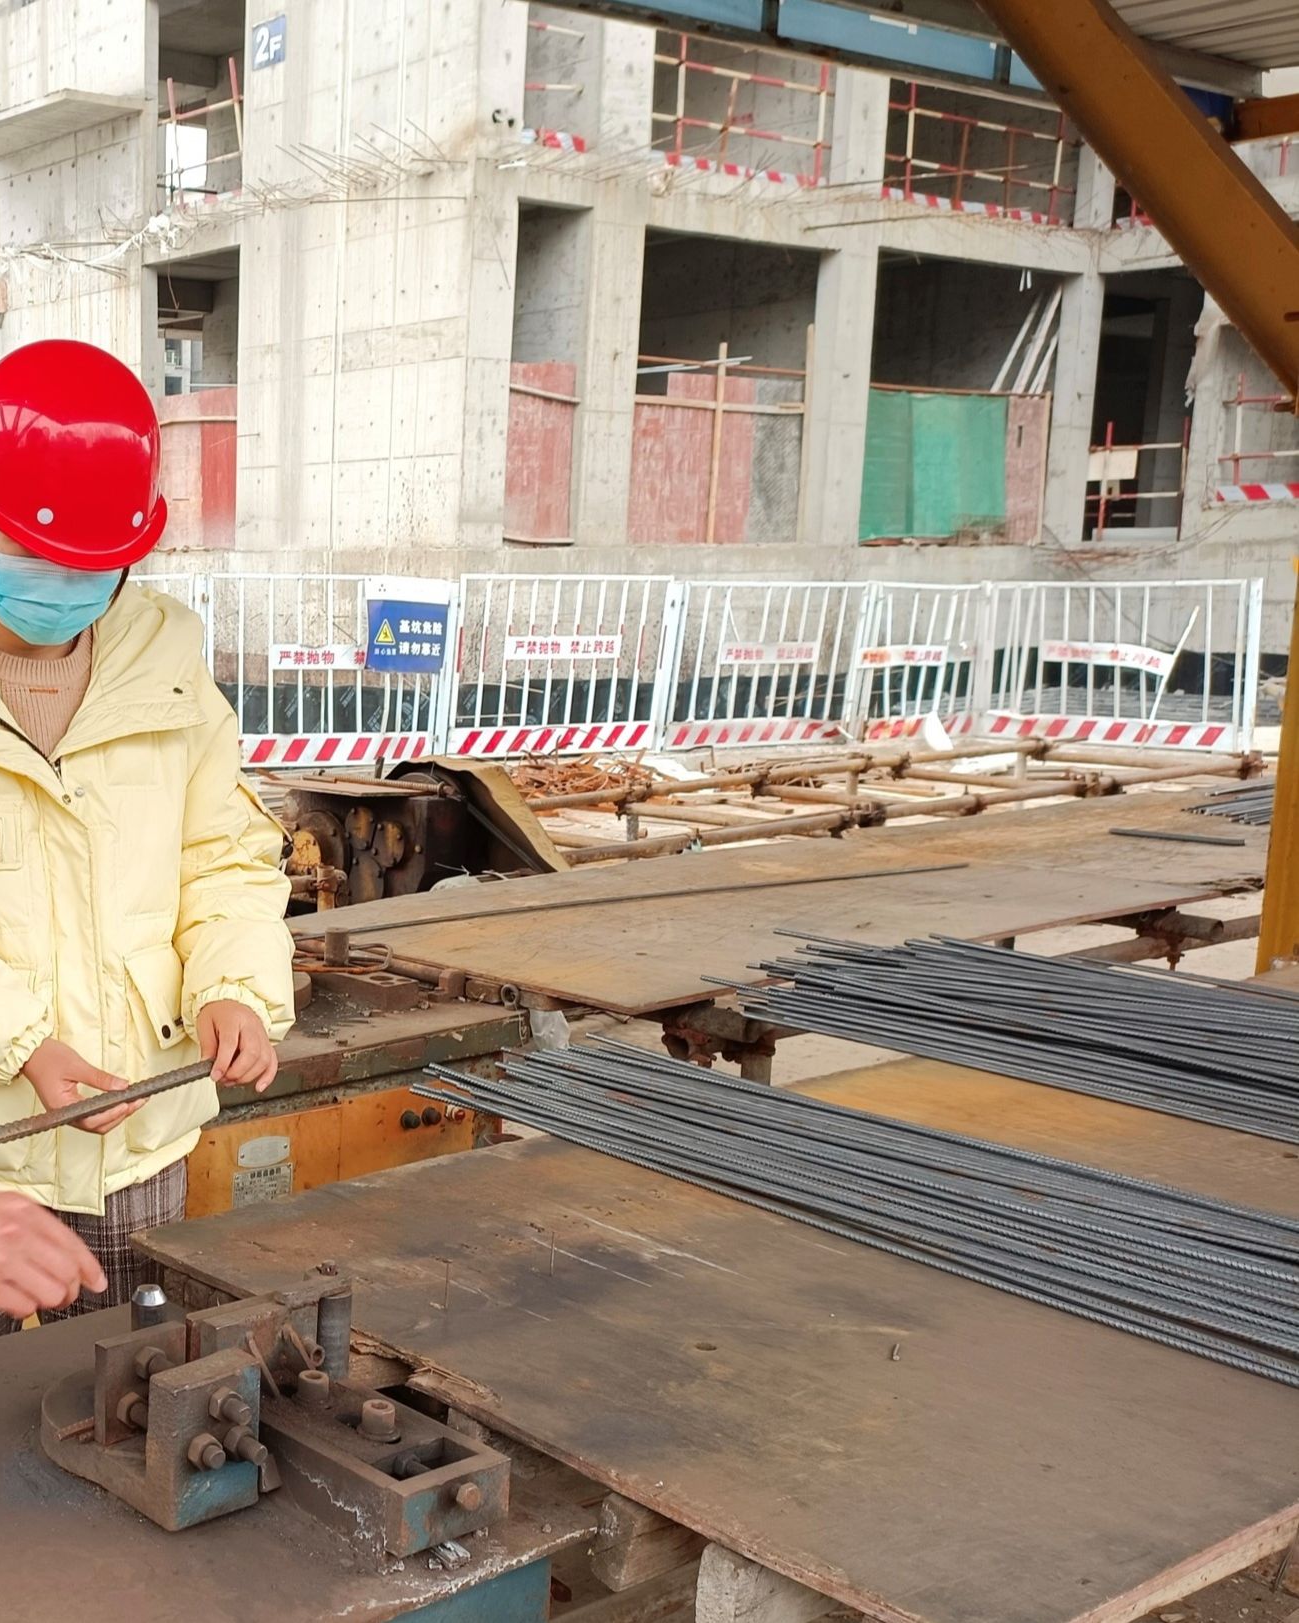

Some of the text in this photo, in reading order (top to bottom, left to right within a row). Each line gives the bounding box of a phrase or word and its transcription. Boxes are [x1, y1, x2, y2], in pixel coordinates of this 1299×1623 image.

[254, 27, 283, 65] 2F
[399, 619, 443, 636] 基坑危险
[399, 641, 441, 657] 请勿靠近
[513, 640, 615, 655] 严禁抛物 禁止跨越
[278, 650, 335, 665] 严禁抛物
